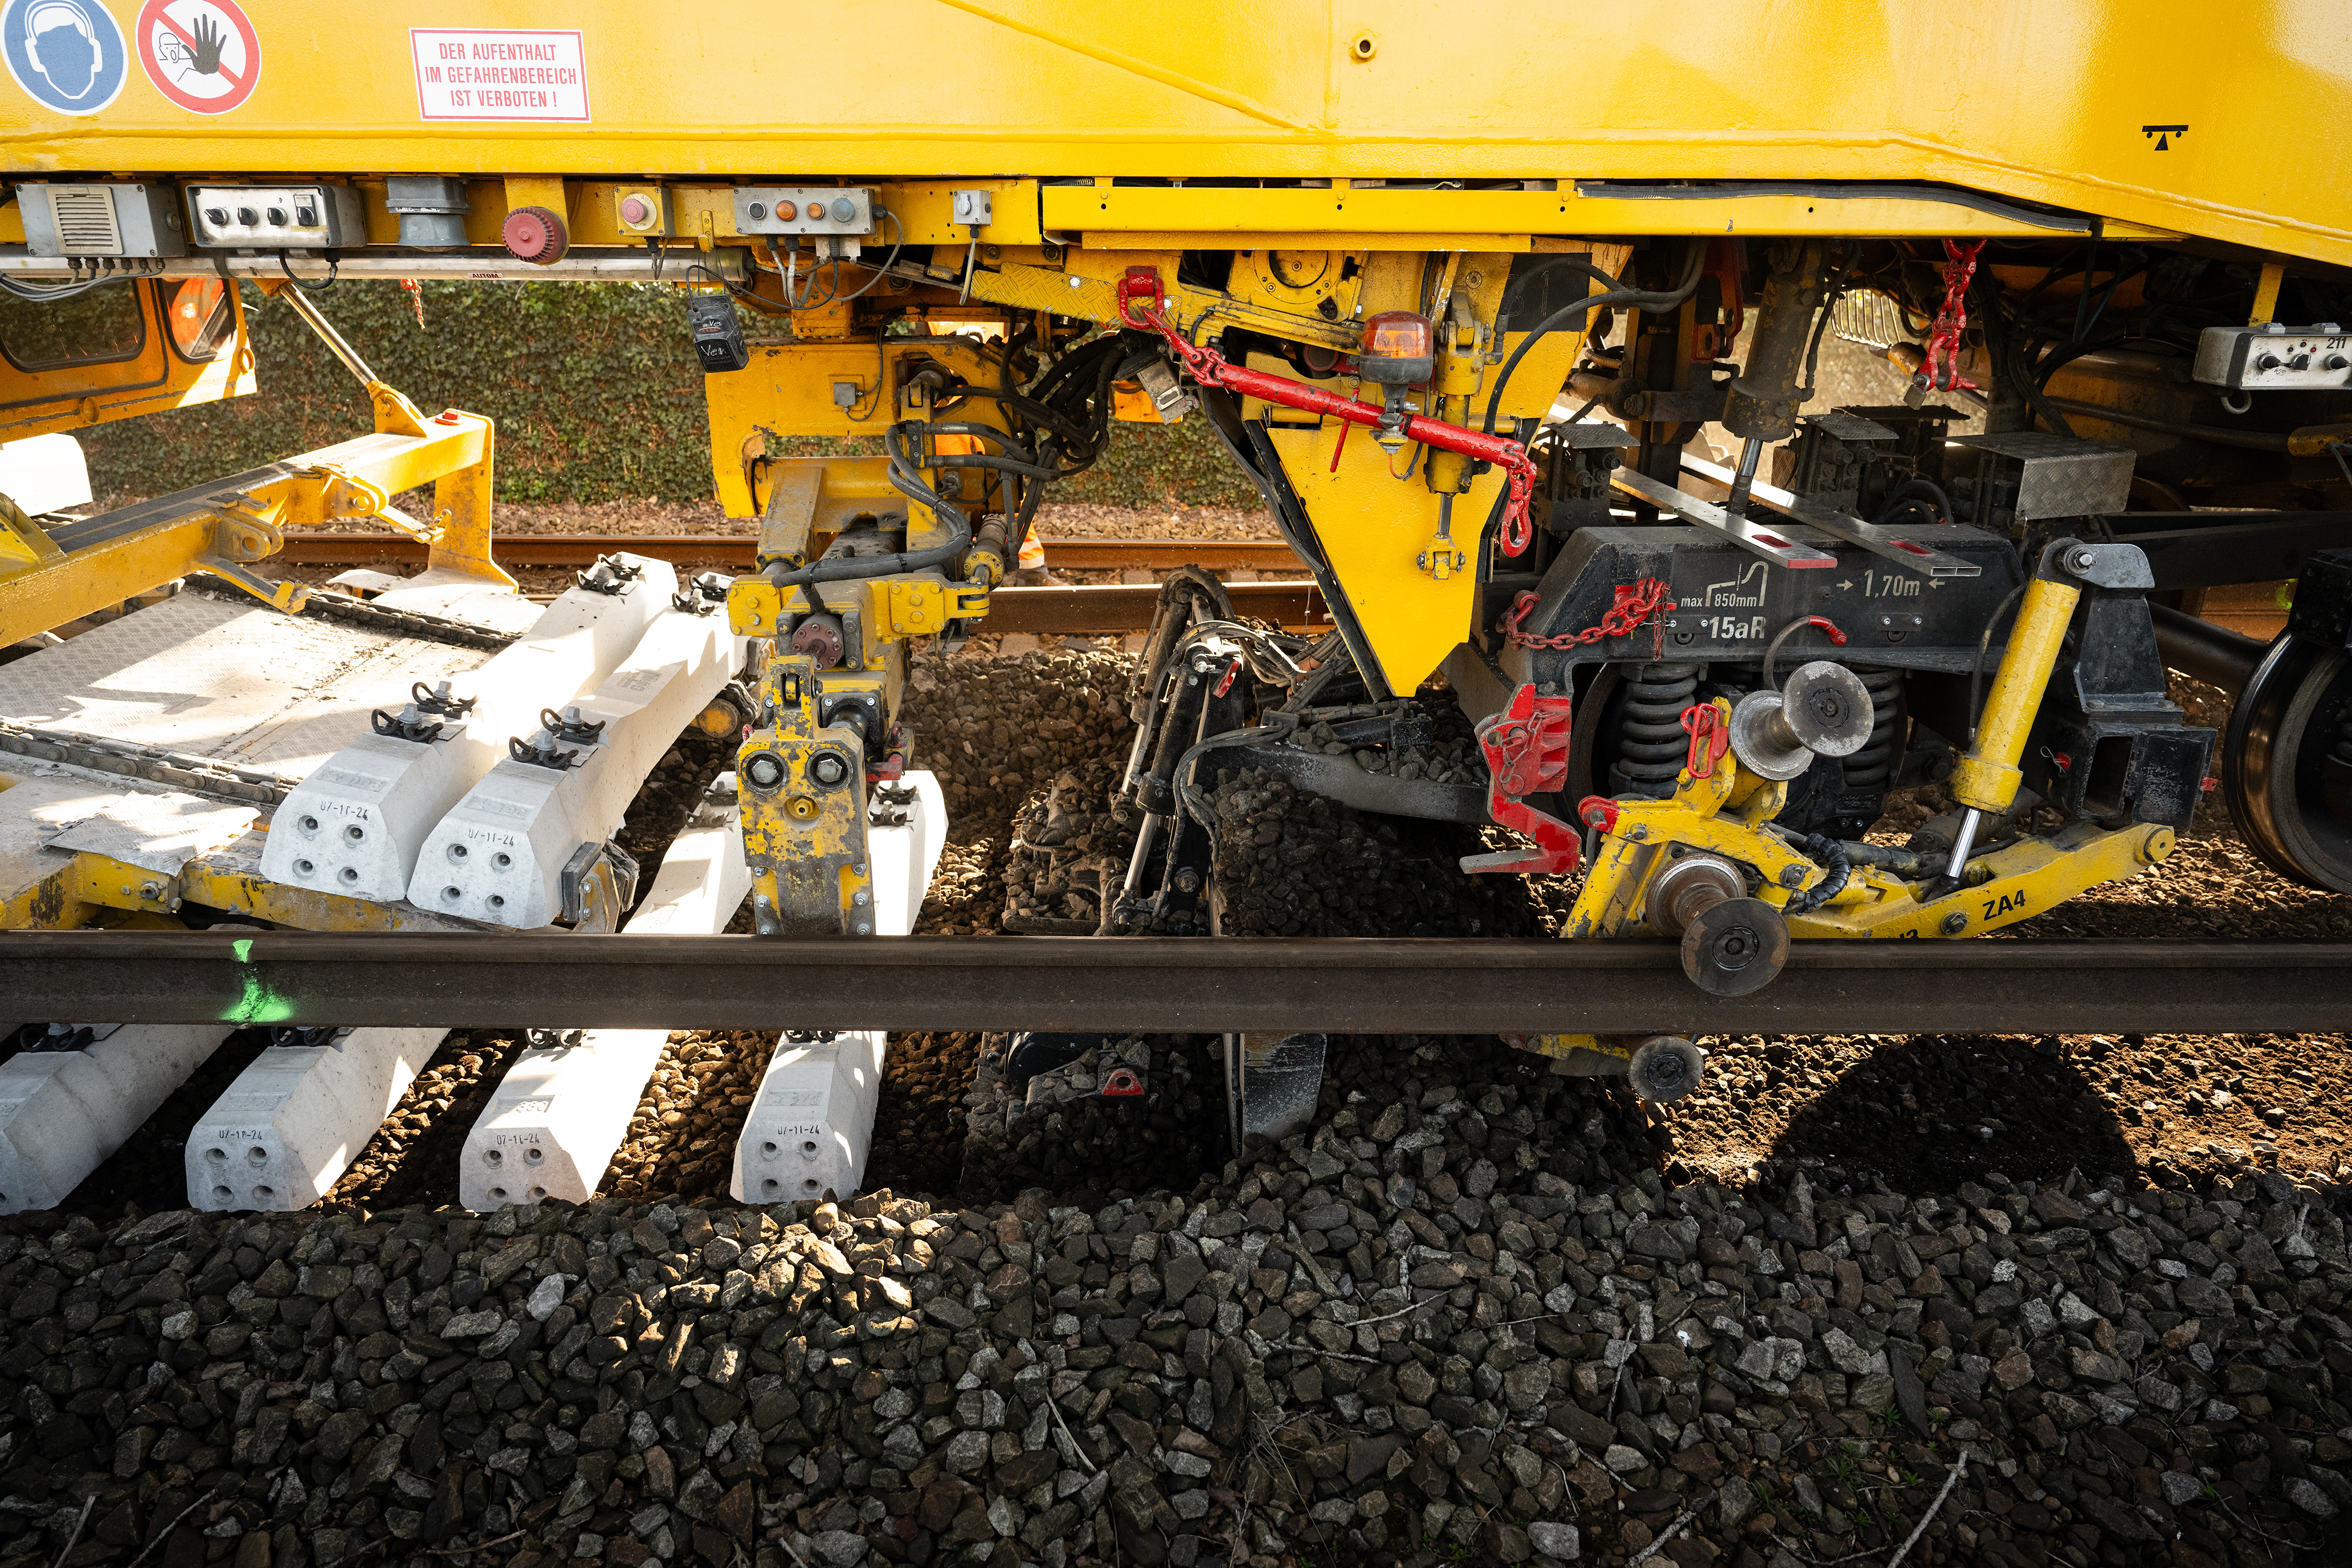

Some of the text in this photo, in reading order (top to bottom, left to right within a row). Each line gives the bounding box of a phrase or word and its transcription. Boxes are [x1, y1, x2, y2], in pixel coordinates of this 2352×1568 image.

[439, 43, 556, 61] DER AUFENTHALT
[425, 66, 577, 84] IM GEFAHRENBEREICH
[450, 89, 557, 107] IST VERBOTEN !
[641, 194, 652, 205] AUS
[2326, 337, 2347, 349] 211
[1864, 570, 1921, 599] 1,70m
[1680, 593, 1757, 607] max 850mm
[1710, 616, 1767, 639] 15aR
[1982, 889, 2026, 921] ZA4
